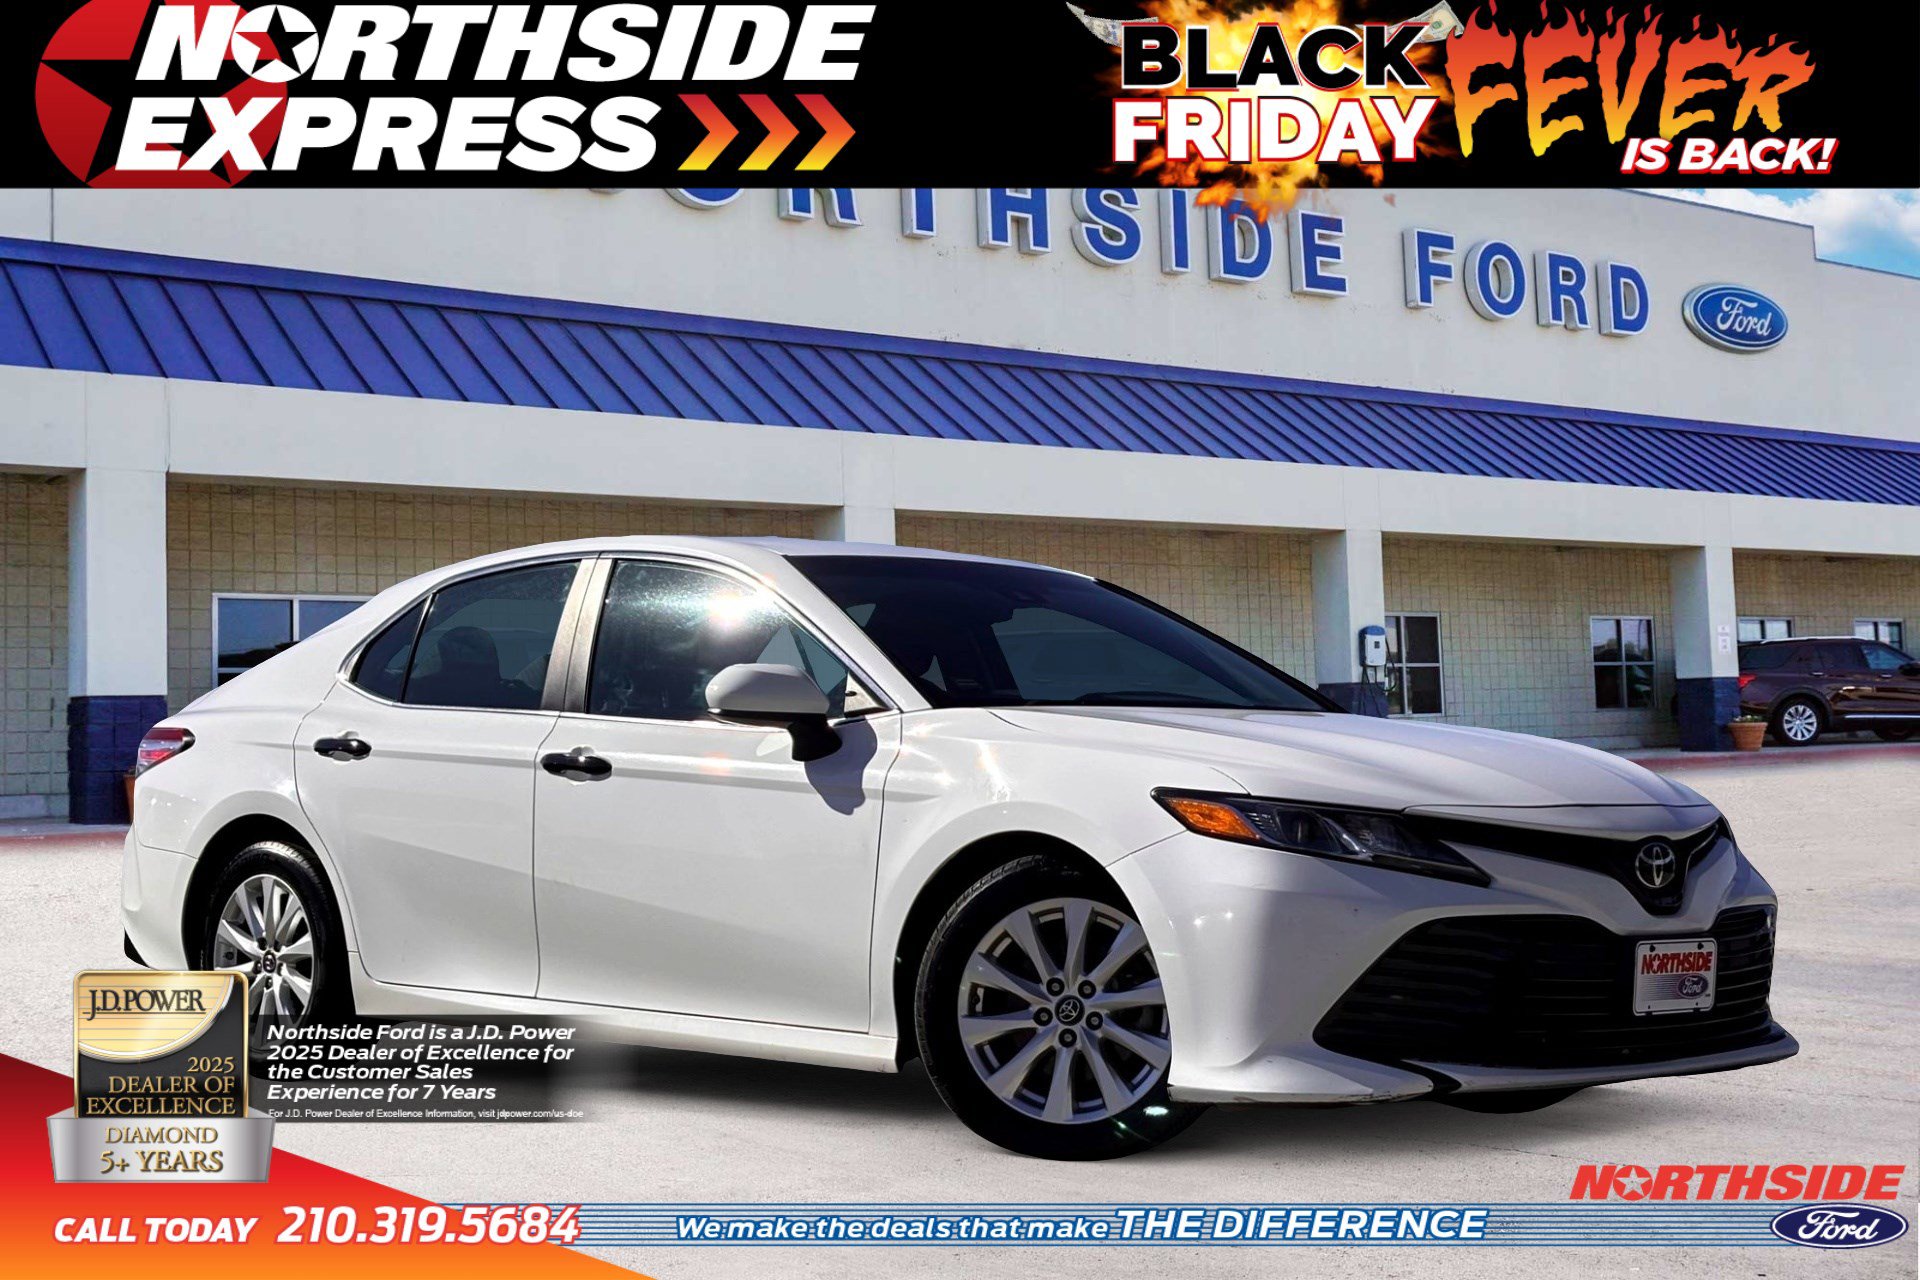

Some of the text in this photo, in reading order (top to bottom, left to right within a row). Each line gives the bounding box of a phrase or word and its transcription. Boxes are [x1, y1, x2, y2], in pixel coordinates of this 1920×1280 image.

[1403, 228, 1650, 338] FORD
[1715, 295, 1773, 338] Ford
[1641, 951, 1713, 975] NORTHSIDE
[1682, 976, 1703, 994] Ford
